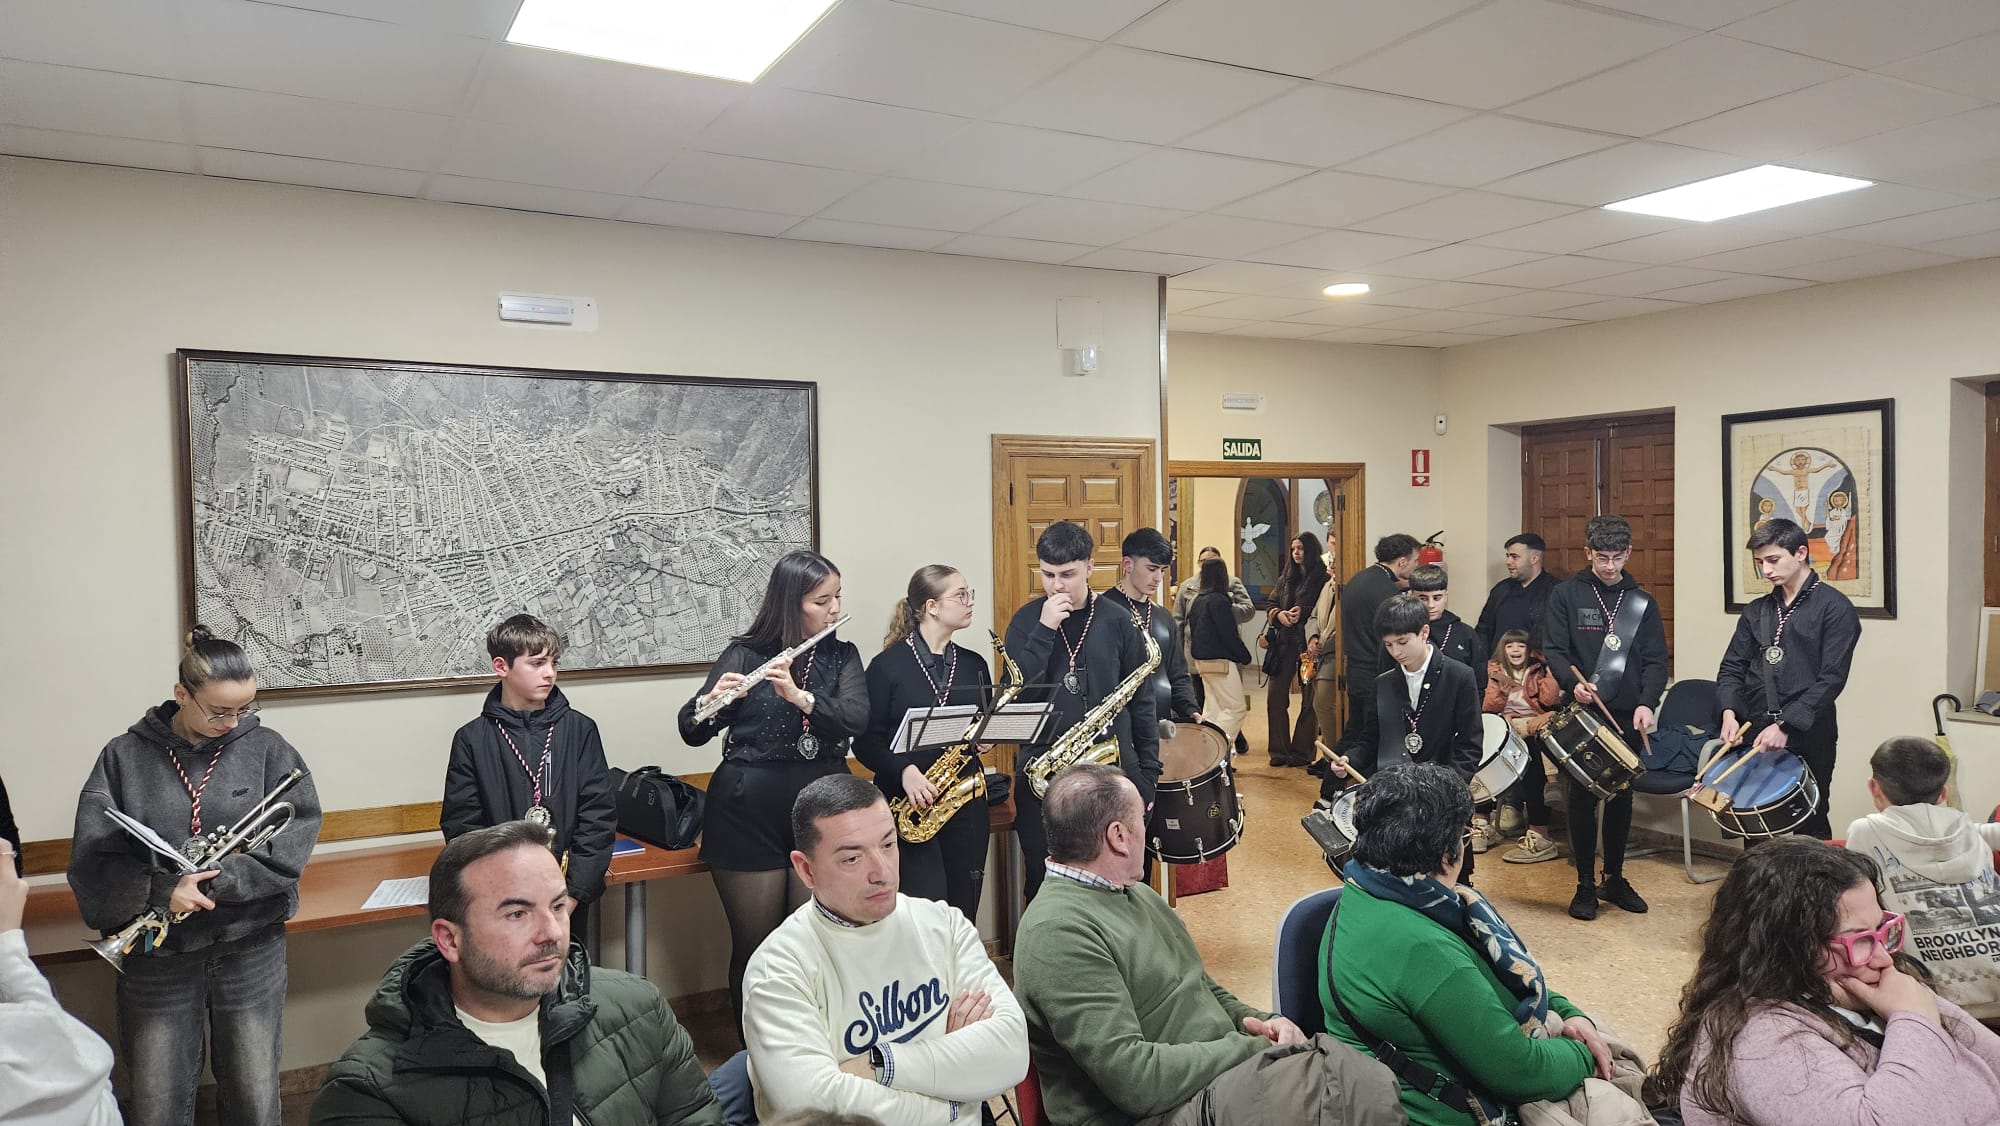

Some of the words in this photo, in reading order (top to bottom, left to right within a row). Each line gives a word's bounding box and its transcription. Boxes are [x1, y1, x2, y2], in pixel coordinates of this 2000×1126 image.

[1223, 441, 1261, 457] SALIDA
[1913, 926, 2000, 949] BROOKLYN
[1919, 940, 2000, 962] NEIGHBOR
[844, 977, 949, 1055] Silbon
